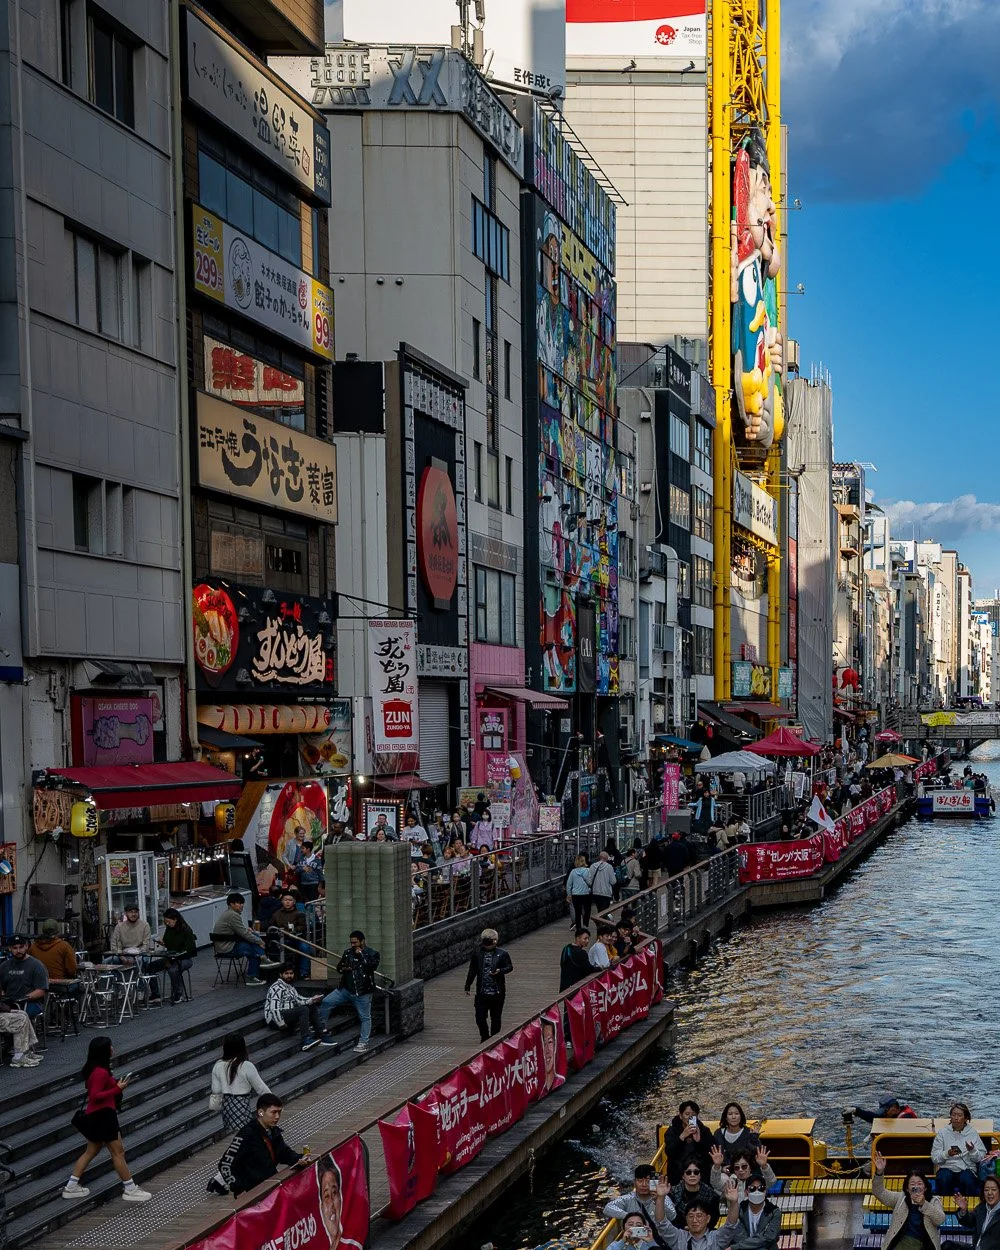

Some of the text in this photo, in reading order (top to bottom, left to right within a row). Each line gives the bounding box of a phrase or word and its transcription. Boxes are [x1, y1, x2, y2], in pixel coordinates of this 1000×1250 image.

[254, 279, 310, 330] 餃子のかっちゃん
[222, 418, 304, 503] うなぎ
[252, 616, 326, 684] ずんどう屋
[374, 637, 410, 694] ずんどう屋
[385, 711, 410, 723] ZUN
[221, 1136, 243, 1184] HILFIGER
